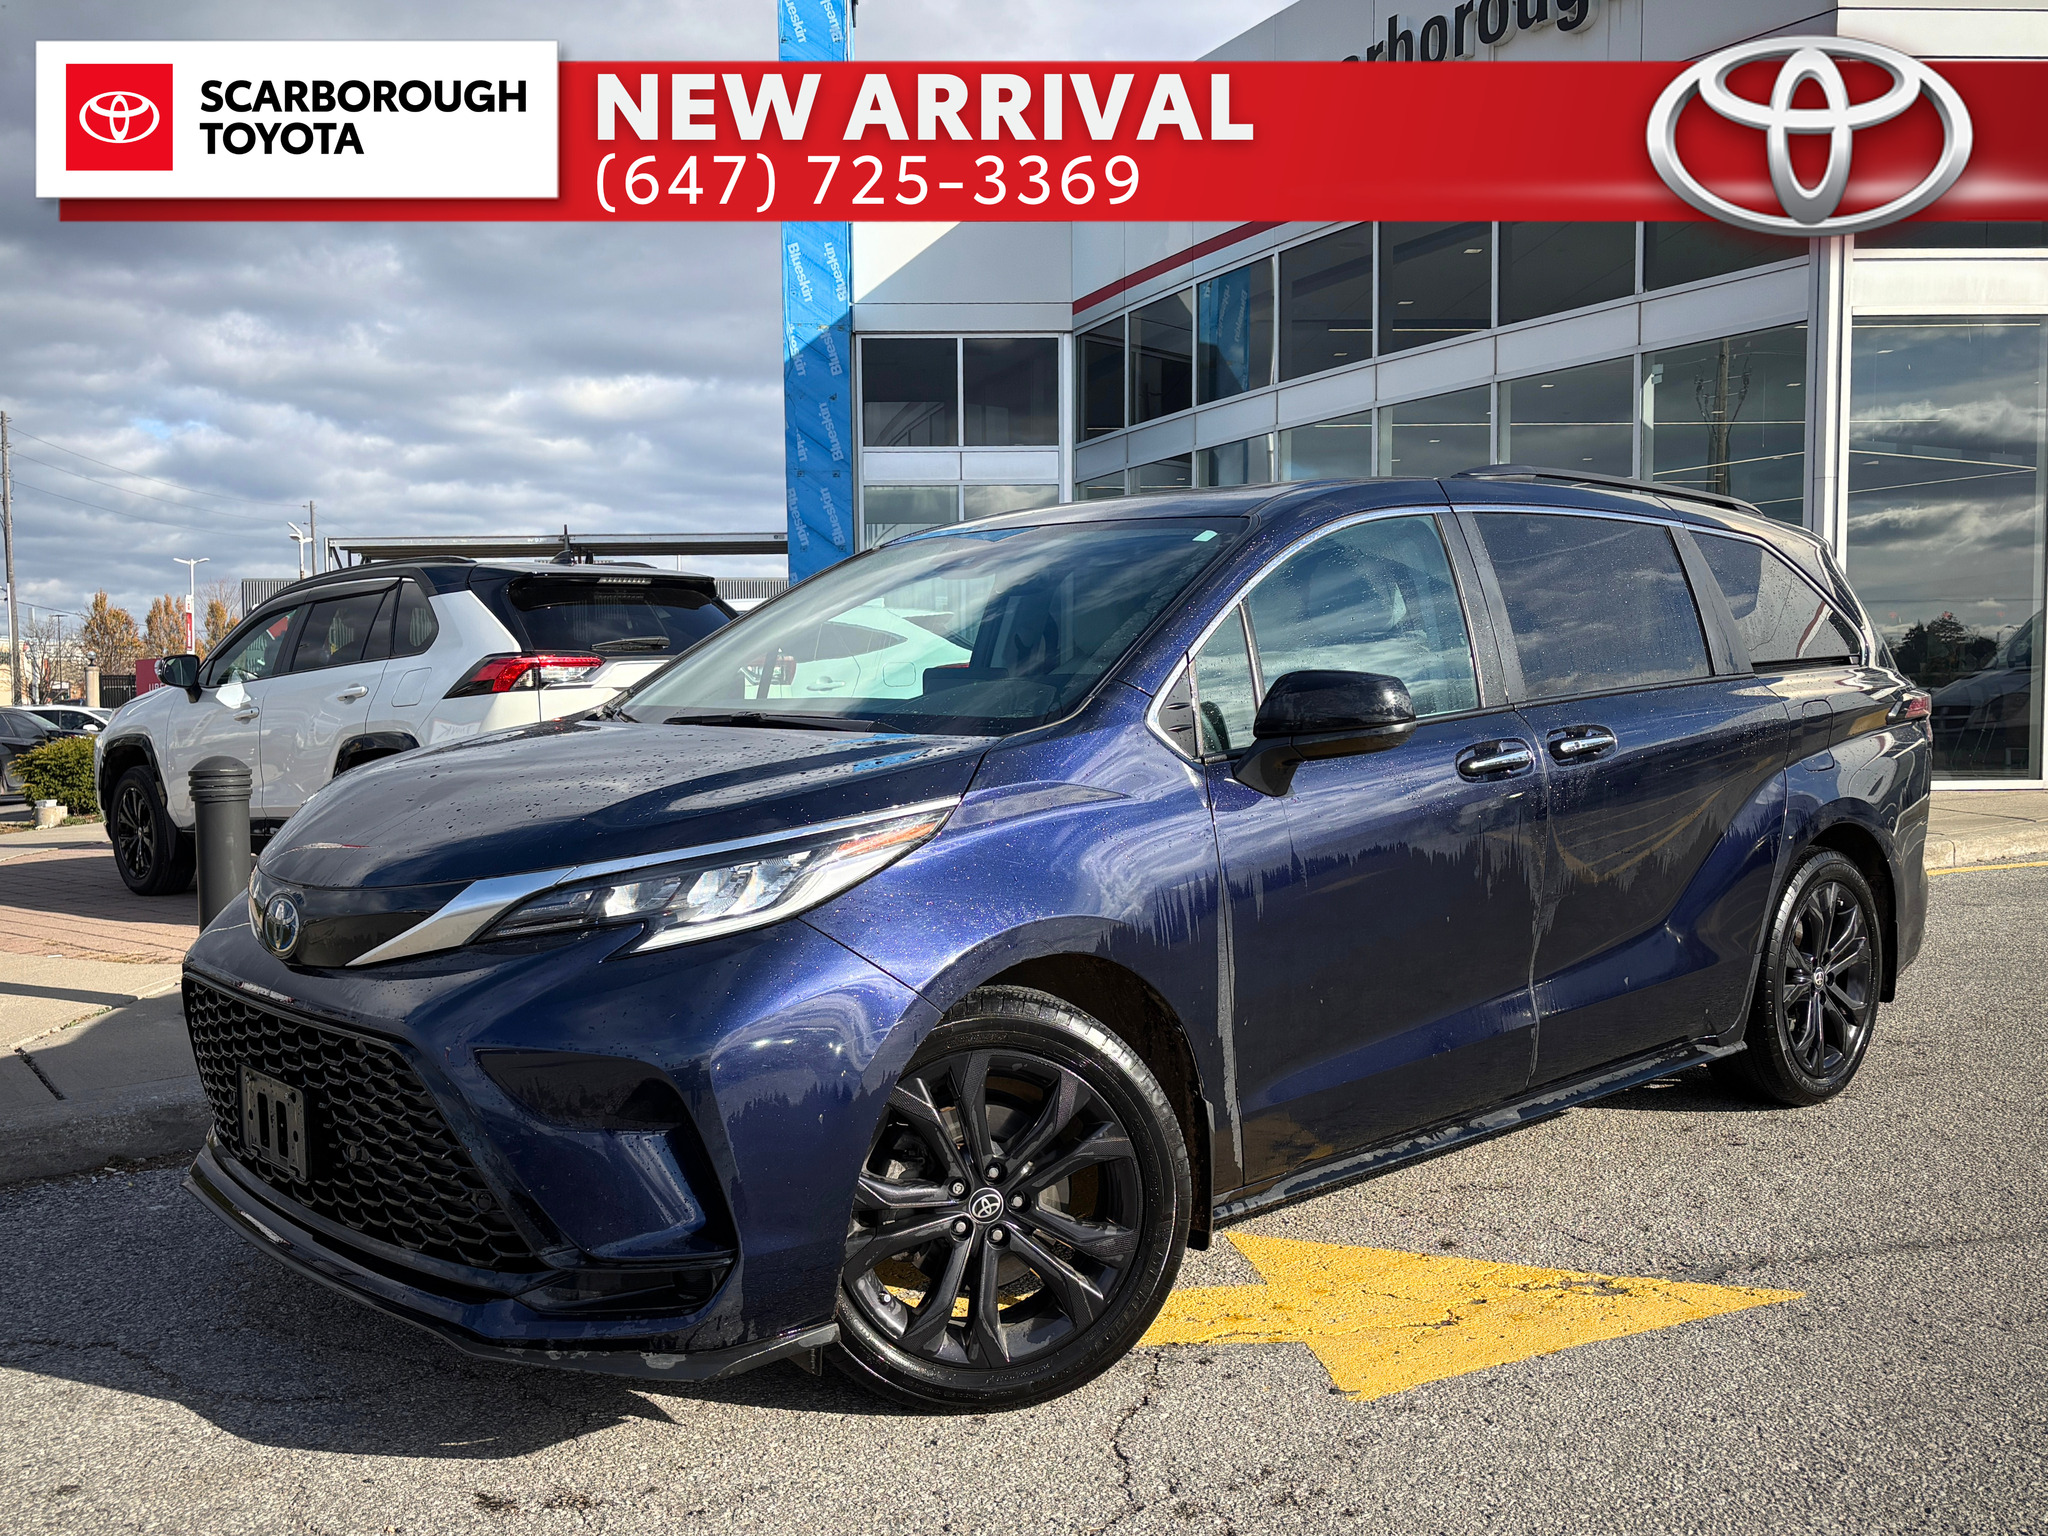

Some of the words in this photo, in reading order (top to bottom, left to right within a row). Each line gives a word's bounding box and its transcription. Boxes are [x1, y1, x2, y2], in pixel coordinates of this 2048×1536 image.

[787, 242, 813, 302] Blueskin
[824, 242, 847, 302] Blueskin
[819, 402, 844, 461] Blueskin
[788, 487, 809, 547] Blueskin
[820, 487, 846, 547] Blueskin
